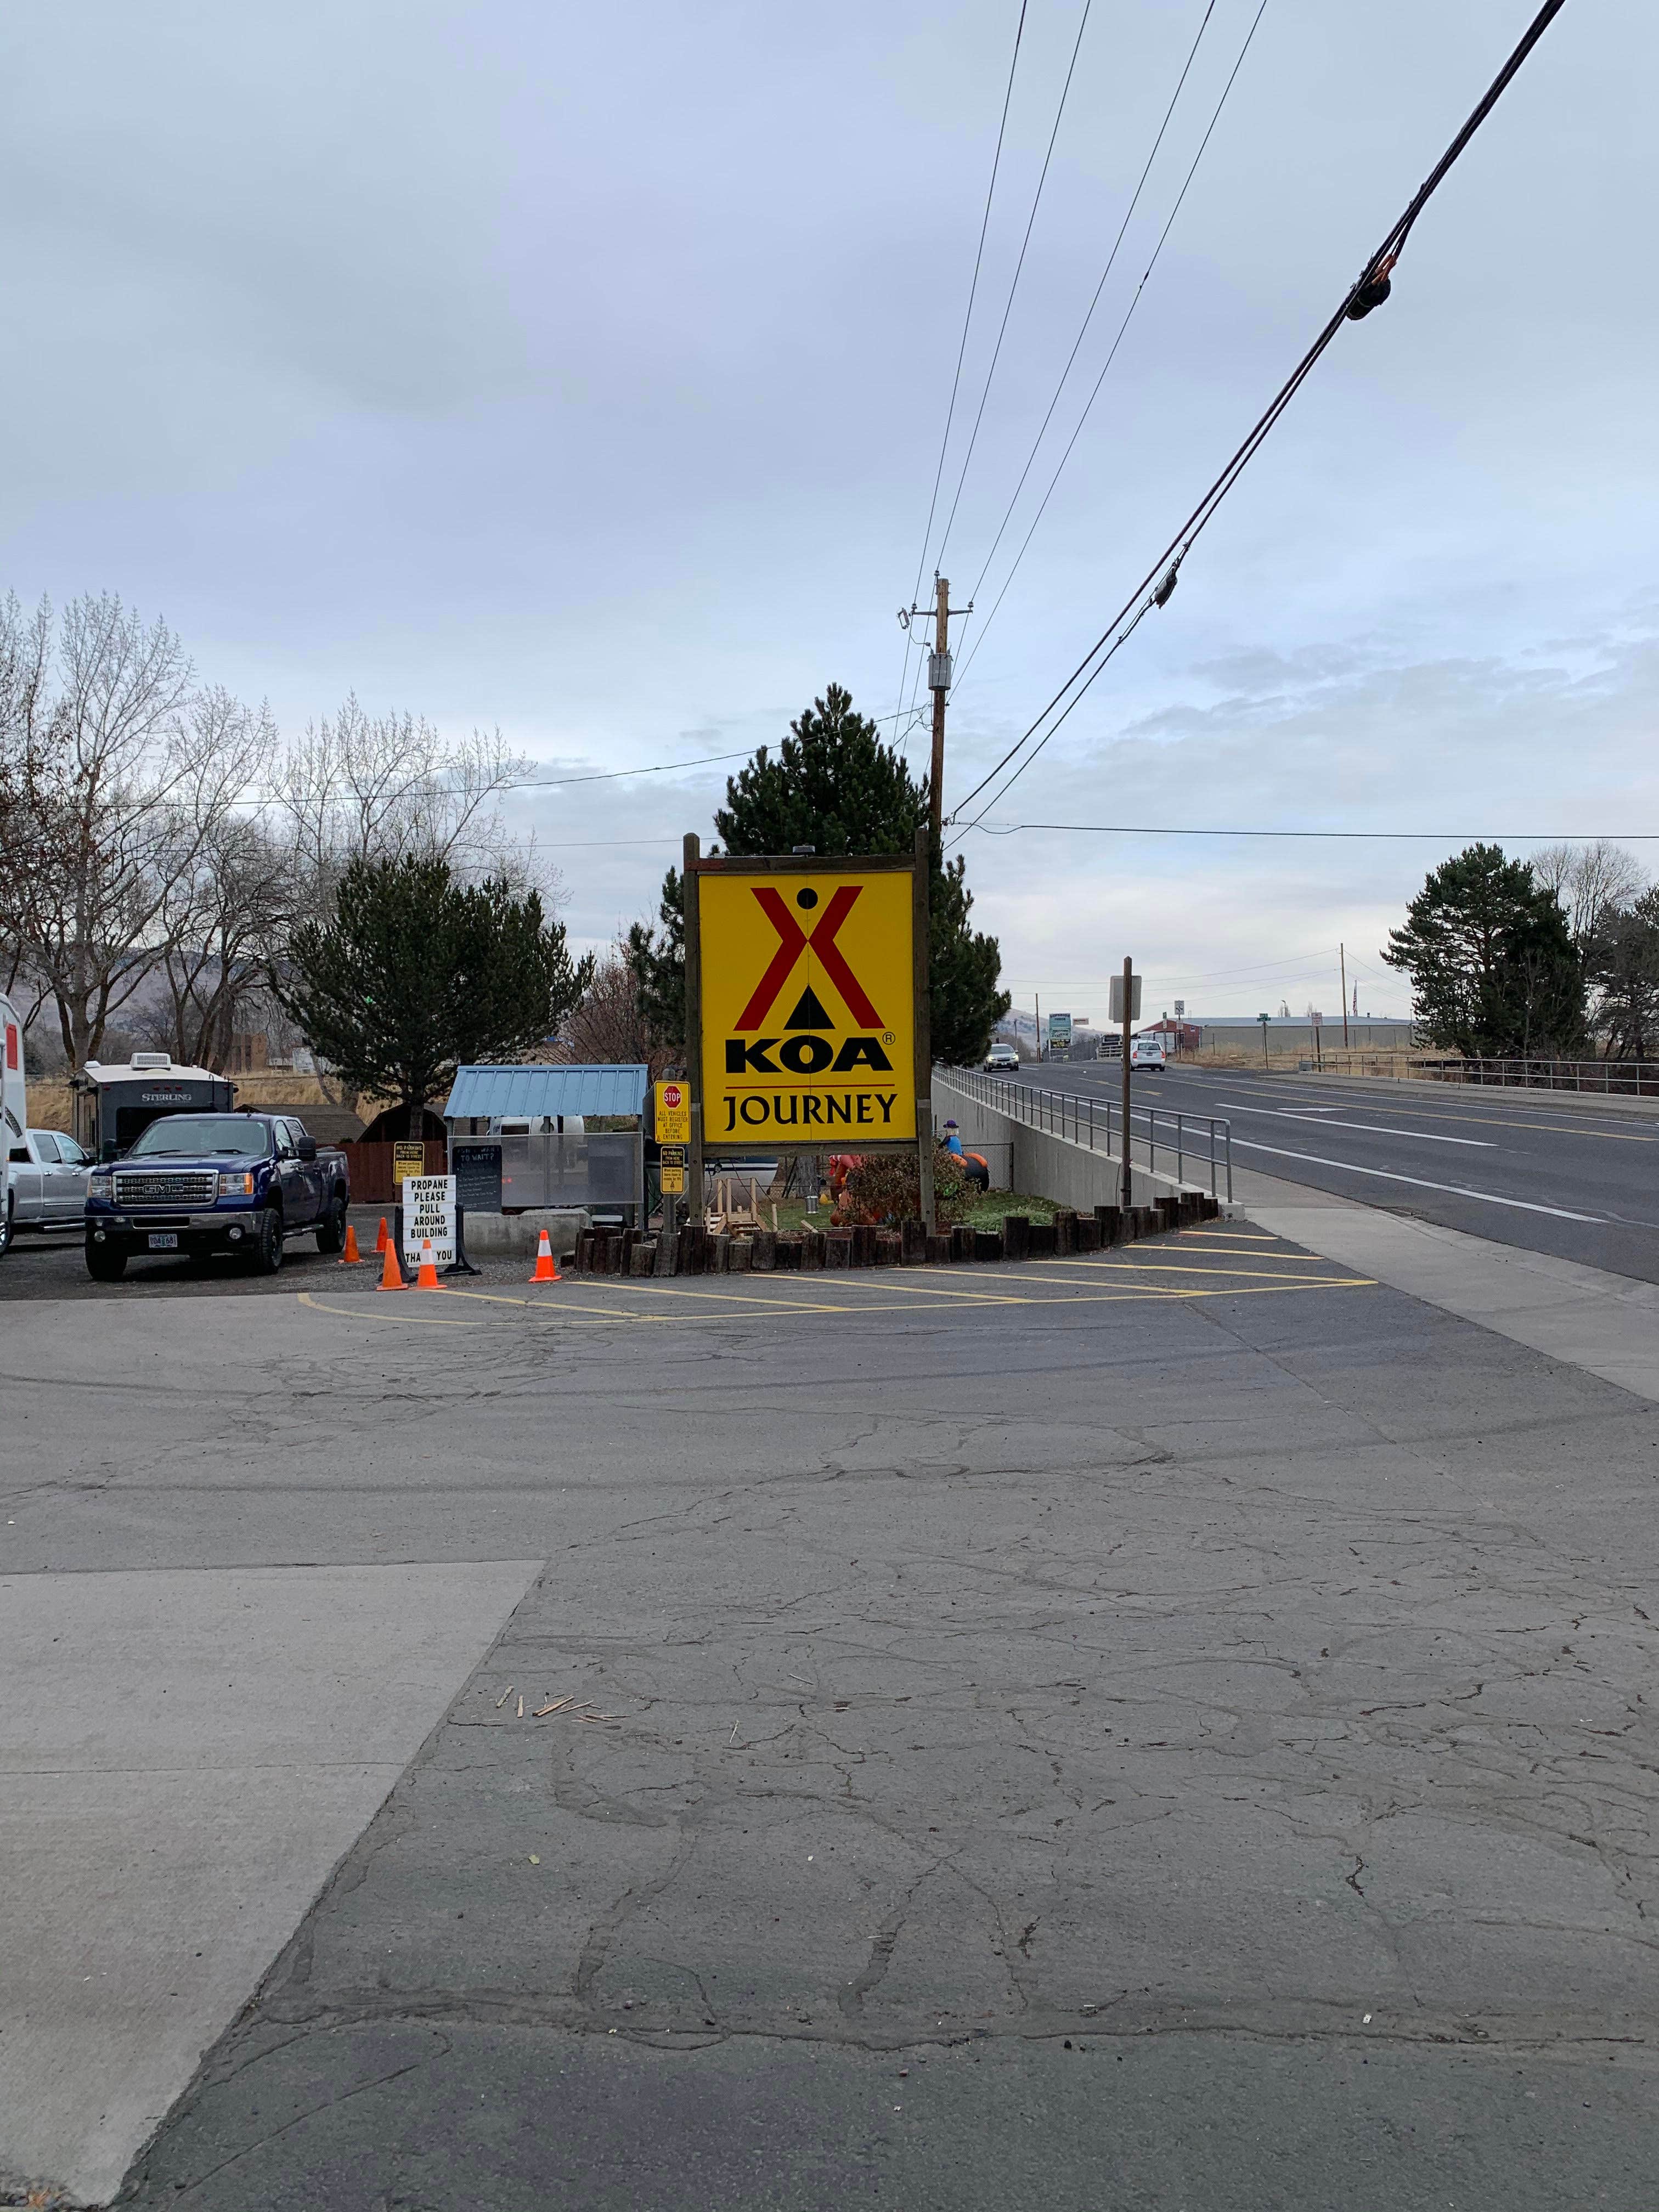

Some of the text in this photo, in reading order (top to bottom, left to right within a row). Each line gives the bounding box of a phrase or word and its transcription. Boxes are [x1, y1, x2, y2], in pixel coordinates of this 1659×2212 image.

[142, 1093, 192, 1102] STERLING
[664, 1092, 681, 1102] STOP
[723, 1094, 898, 1132] JOURNEY
[472, 1153, 494, 1161] WAIT?
[143, 1184, 183, 1194] GMC
[411, 1180, 448, 1190] PROPANE
[414, 1192, 445, 1202] PLEASE
[420, 1204, 440, 1214] PULL
[414, 1215, 445, 1226] AROUND
[411, 1227, 448, 1238] BUILDING
[405, 1250, 452, 1262] THA YOU
